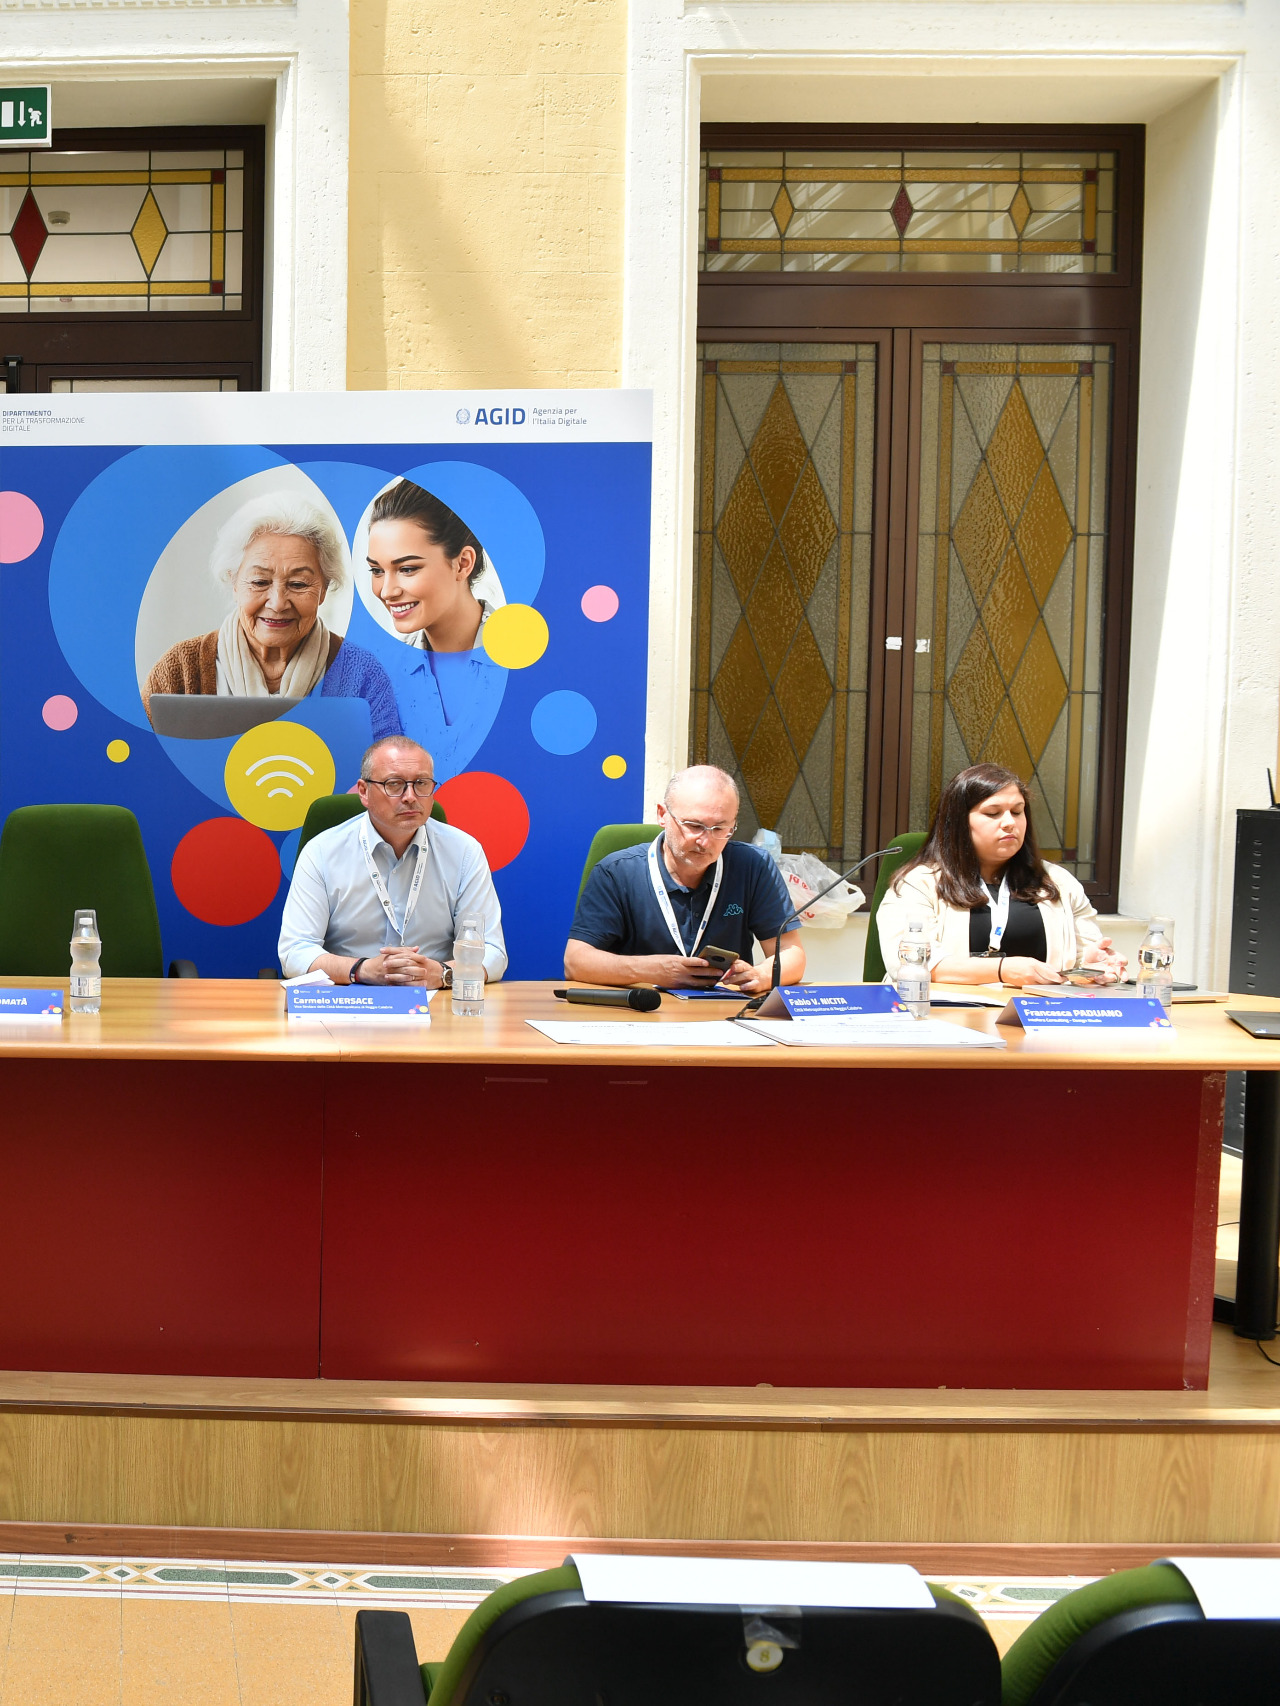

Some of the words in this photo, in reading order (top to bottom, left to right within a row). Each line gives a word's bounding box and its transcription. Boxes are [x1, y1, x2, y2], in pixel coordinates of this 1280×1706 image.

[475, 408, 526, 425] AGID
[533, 408, 562, 416] Agenzia
[558, 418, 587, 426] Digitale
[788, 998, 811, 1006] Fabio
[820, 997, 848, 1006] NICITA
[1024, 1008, 1072, 1016] Francesca
[1074, 1010, 1122, 1018] PADUANO
[760, 1649, 770, 1662] 8
